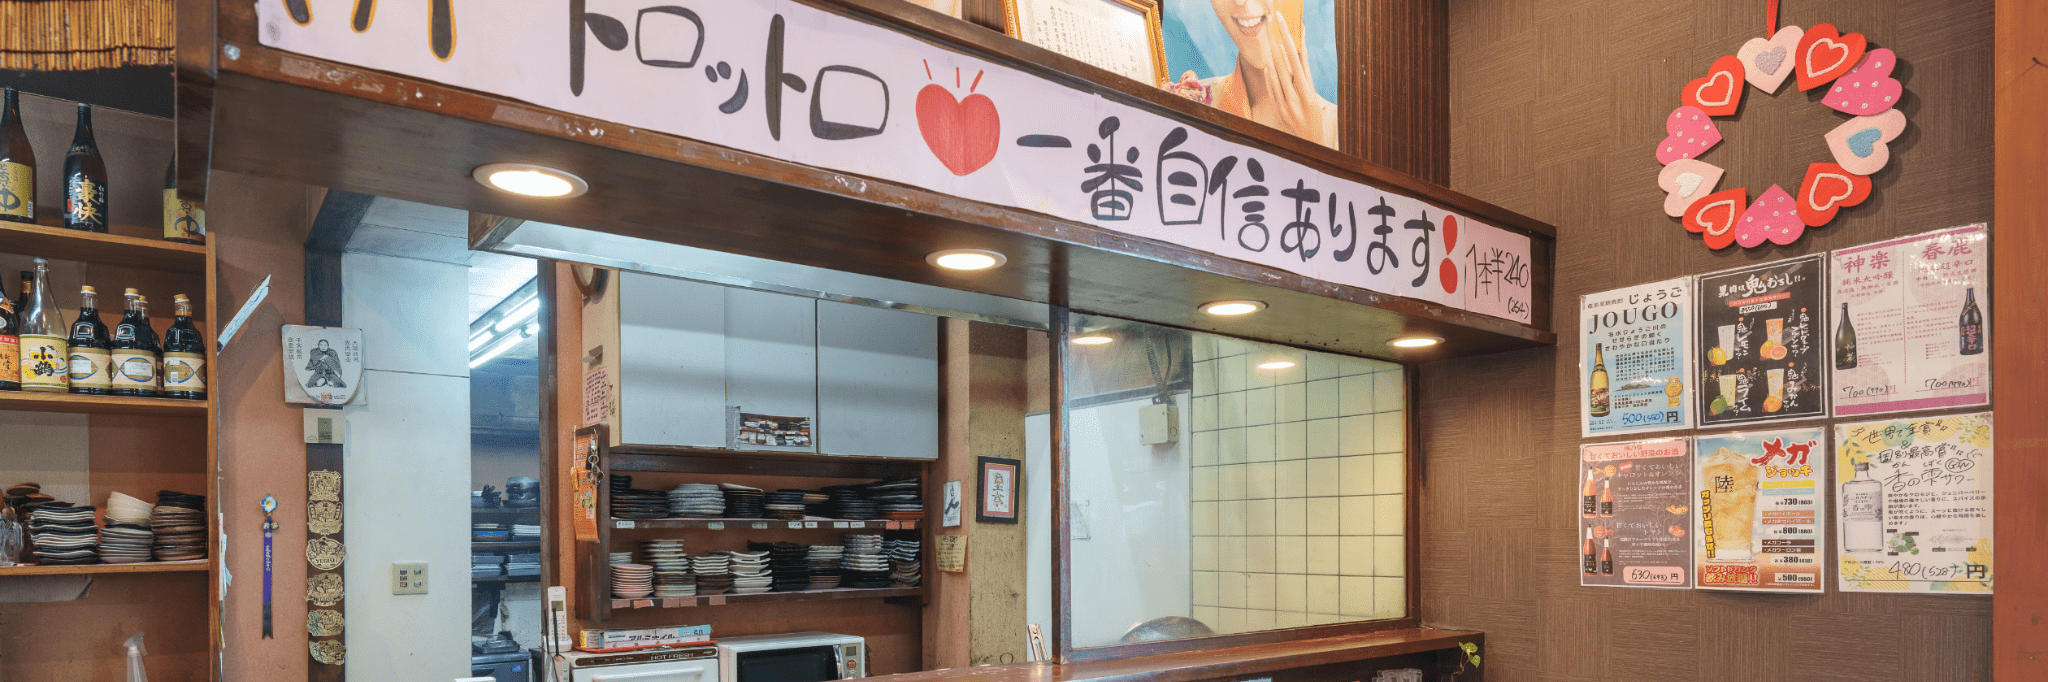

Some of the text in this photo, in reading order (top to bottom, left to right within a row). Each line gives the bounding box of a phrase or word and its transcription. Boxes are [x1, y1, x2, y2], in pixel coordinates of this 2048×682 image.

[1844, 250, 1891, 273] 神楽
[1842, 271, 1894, 286] 純米大吟醸
[1629, 286, 1682, 305] じょうご
[1508, 297, 1530, 320] (264)
[1589, 302, 1678, 334] JOUGO
[1590, 448, 1679, 460] 甘くておいしい野菜のお酒
[1751, 438, 1817, 466] メガ
[1715, 475, 1734, 494] 陸
